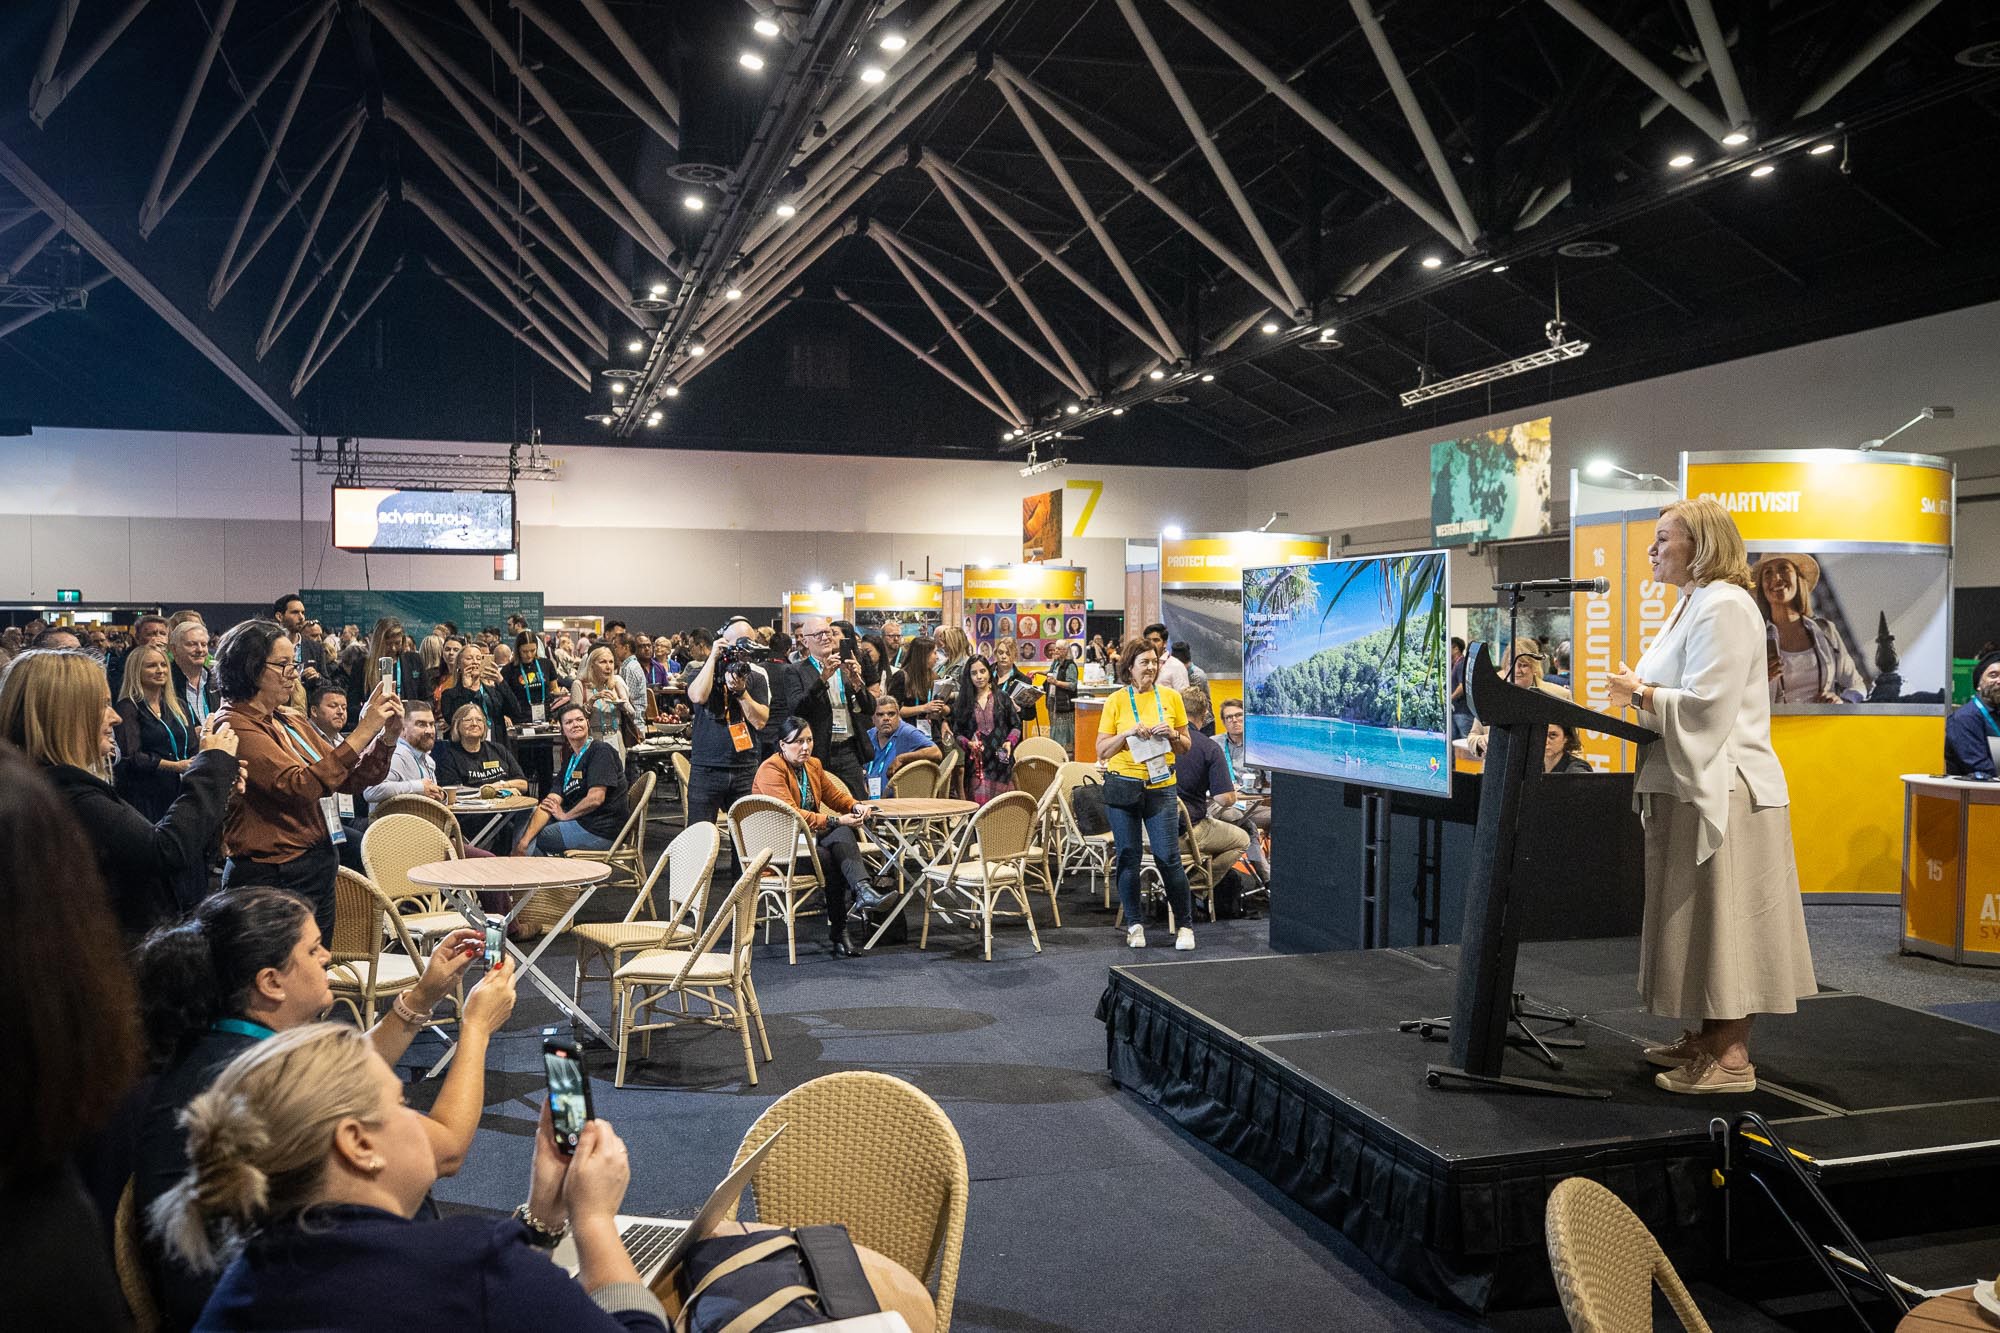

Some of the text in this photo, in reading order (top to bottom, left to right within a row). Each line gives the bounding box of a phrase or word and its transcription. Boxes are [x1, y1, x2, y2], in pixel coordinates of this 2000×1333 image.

[379, 508, 472, 526] adventurous
[1066, 480, 1104, 537] 7
[1167, 555, 1204, 568] PROTECT
[1593, 548, 1605, 567] 16
[468, 766, 504, 778] TASMANIA
[1926, 858, 1943, 881] 15
